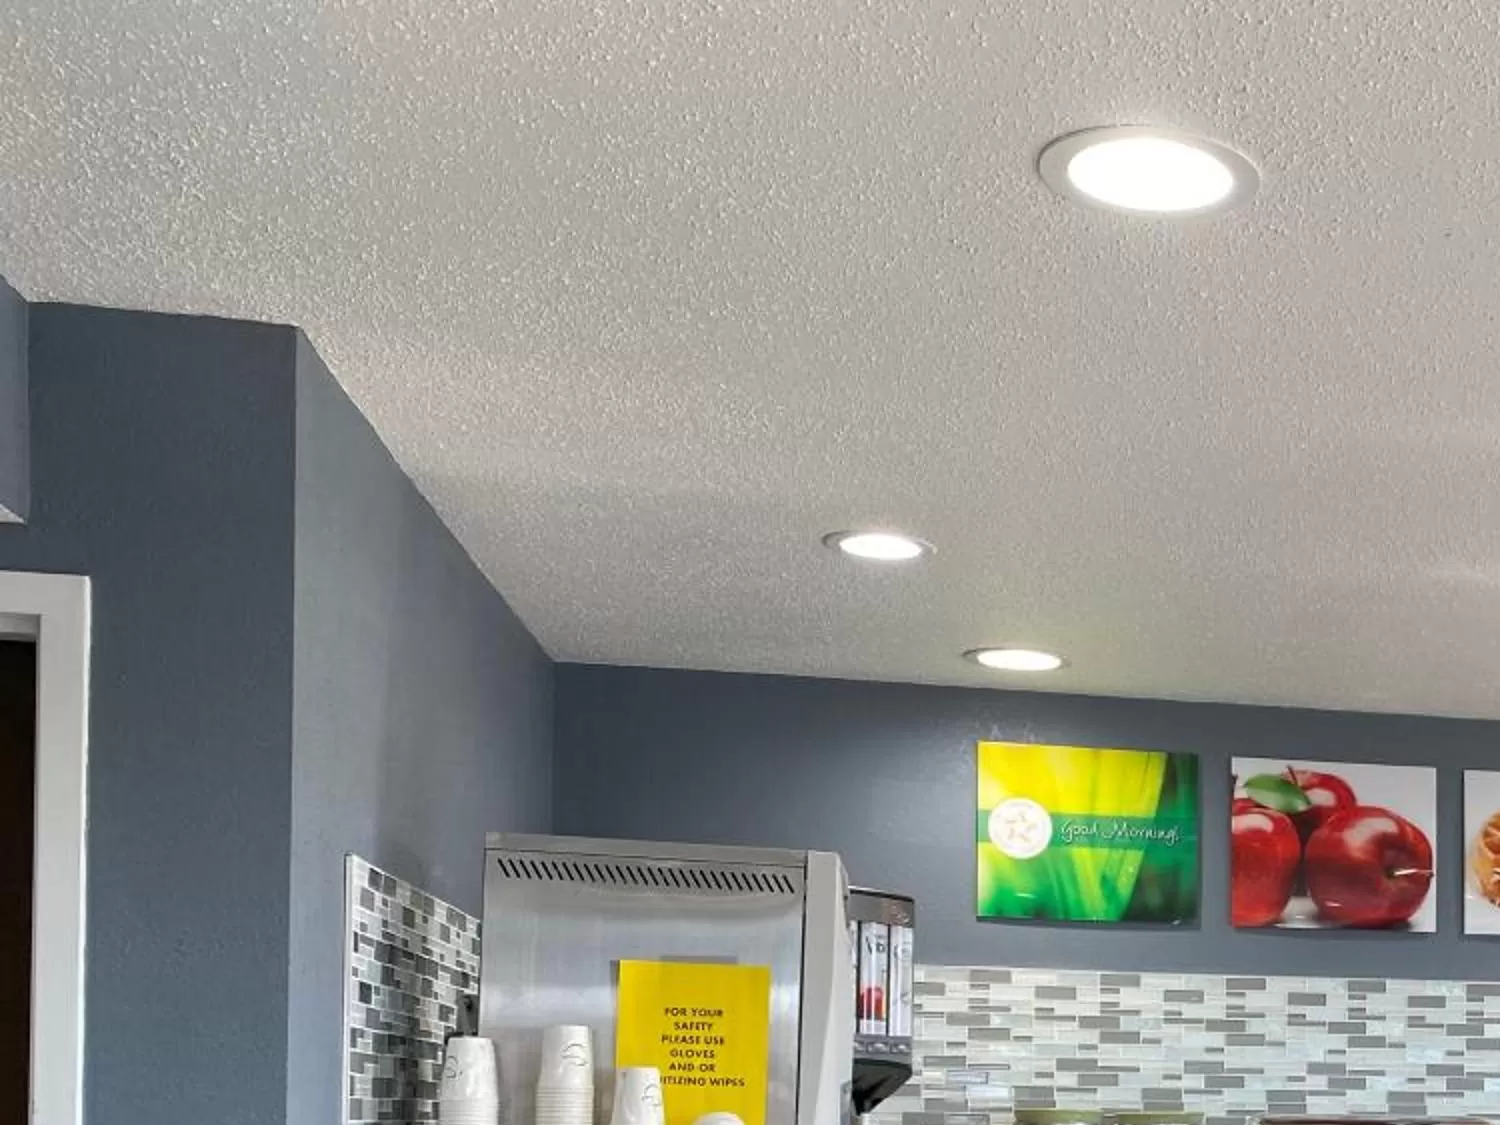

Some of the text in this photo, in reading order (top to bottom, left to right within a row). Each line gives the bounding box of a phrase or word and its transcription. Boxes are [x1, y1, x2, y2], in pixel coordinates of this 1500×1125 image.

[1061, 818, 1099, 846] Good
[664, 1007, 723, 1017] FOR YOUR
[674, 1022, 713, 1031] SAFETY
[661, 1035, 725, 1046] PLEASE USE
[670, 1049, 715, 1058] GLOVES
[660, 1076, 745, 1088] ITIZING WIPES
